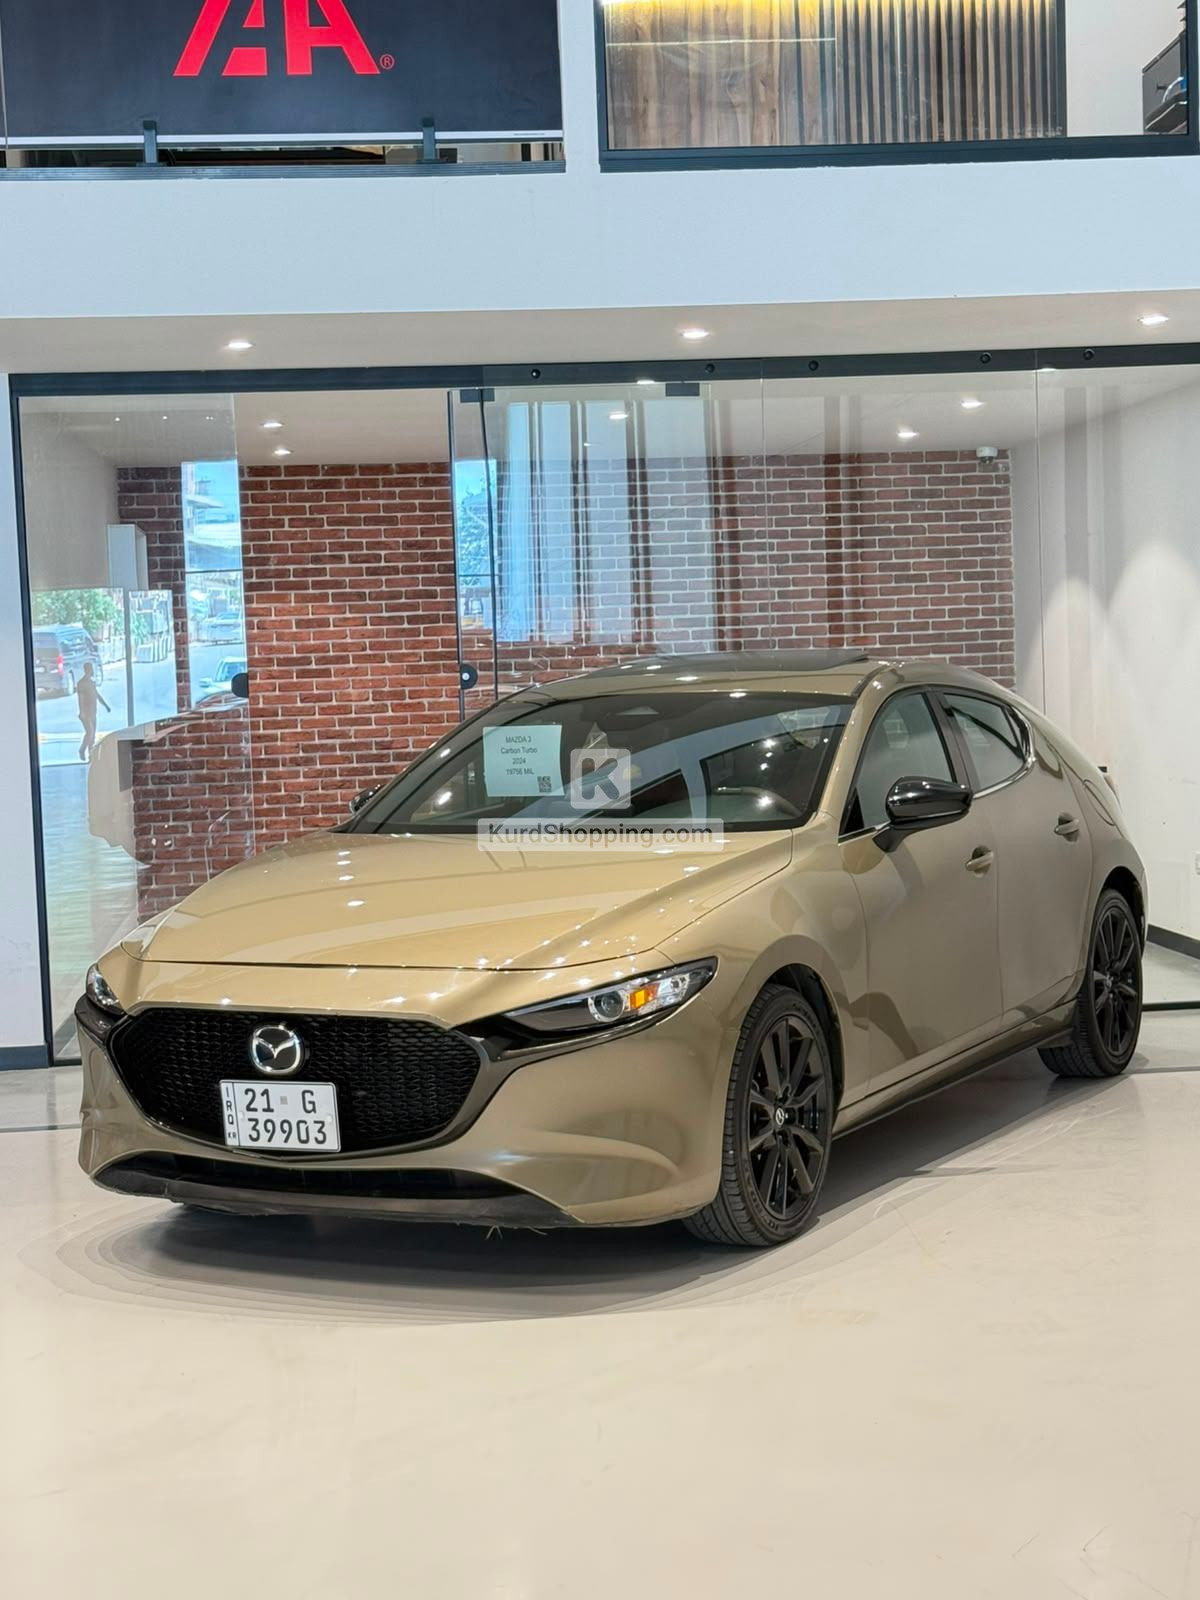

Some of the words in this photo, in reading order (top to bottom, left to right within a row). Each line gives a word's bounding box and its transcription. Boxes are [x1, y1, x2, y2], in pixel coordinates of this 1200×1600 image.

[505, 735, 527, 743] MAZDA
[527, 735, 532, 743] 3
[521, 746, 538, 754] Turbo
[512, 757, 527, 765] 2024
[244, 1088, 274, 1113] 21
[301, 1089, 317, 1114] G
[247, 1117, 327, 1144] 39903
